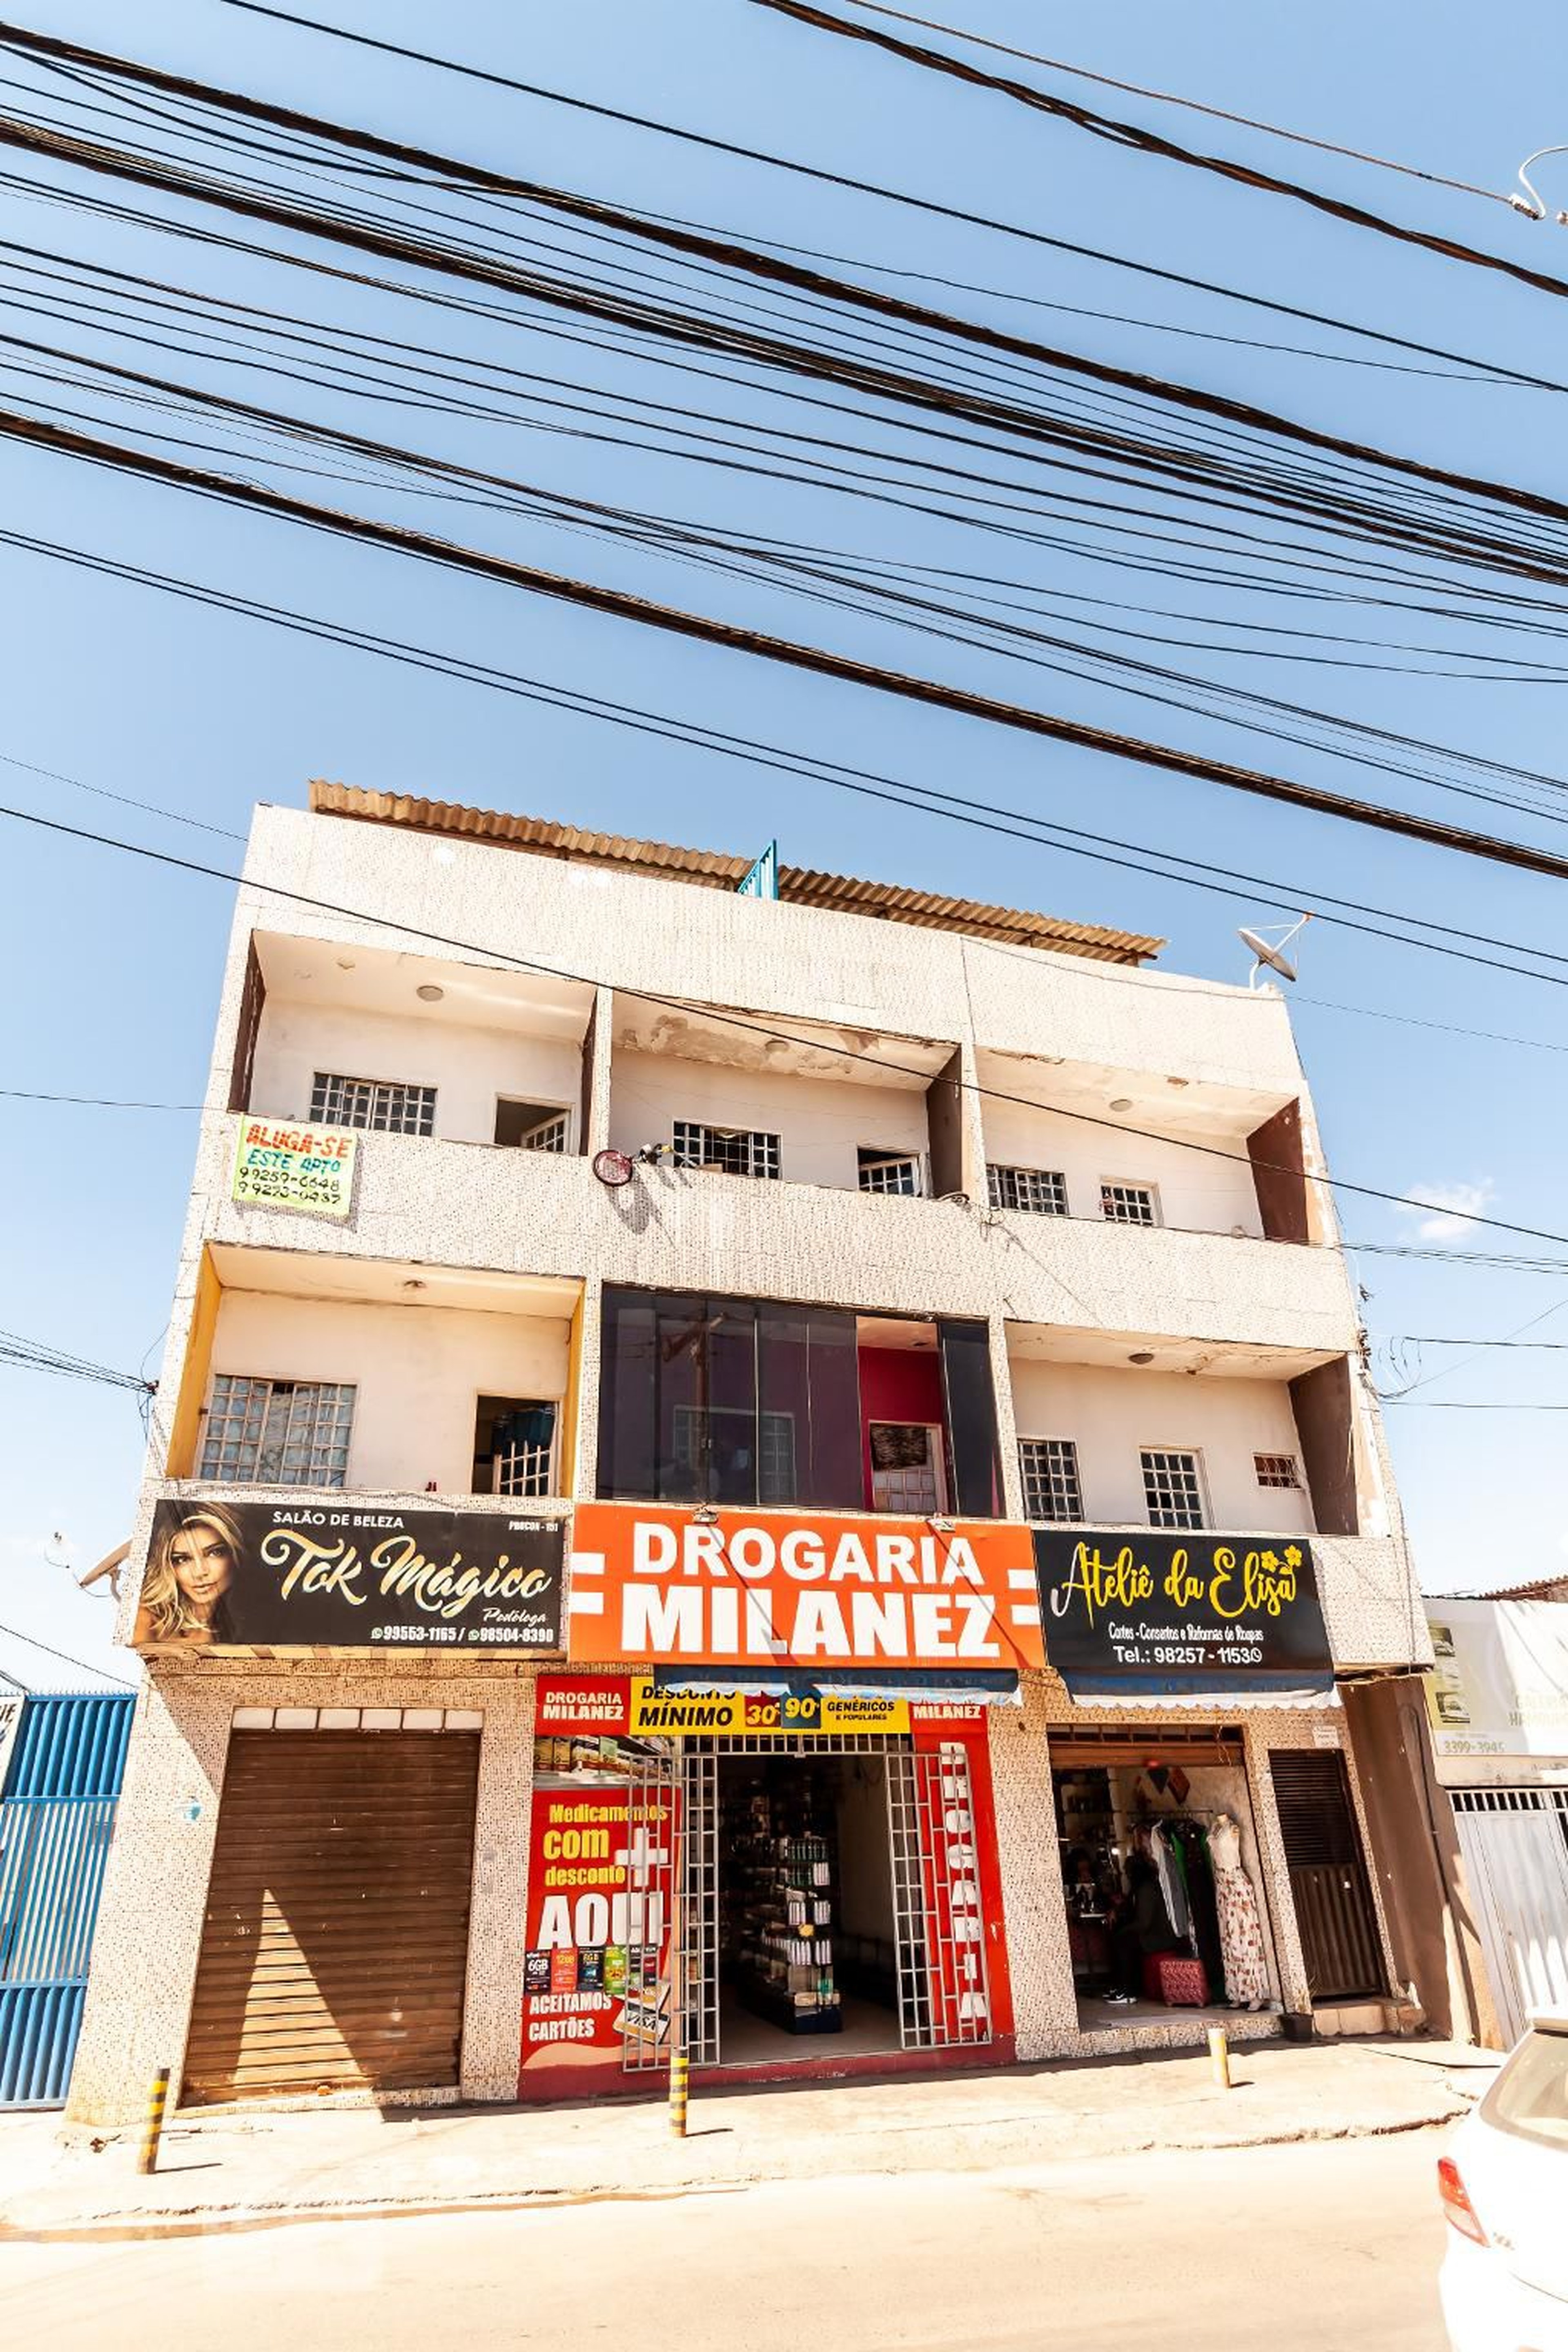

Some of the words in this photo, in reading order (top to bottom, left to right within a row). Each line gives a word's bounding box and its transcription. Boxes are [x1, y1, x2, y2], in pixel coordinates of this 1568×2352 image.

[247, 1124, 352, 1158] ALUGA-SE
[247, 1148, 293, 1169] ESTE
[300, 1157, 341, 1175] APTO
[273, 1510, 326, 1525] SALÃO
[330, 1514, 350, 1526] DE
[353, 1515, 404, 1528] BELEZA
[633, 1522, 984, 1585] DROGARIA
[261, 1528, 367, 1606] Tok
[371, 1535, 552, 1618] Mágico
[1051, 1541, 1154, 1629] Ateliê
[1164, 1549, 1205, 1607] da
[1209, 1548, 1297, 1617] Elisa
[621, 1583, 1000, 1658] MILANEZ
[1108, 1621, 1134, 1640] Cortes
[1180, 1628, 1186, 1641] e
[1225, 1626, 1235, 1642] de
[1235, 1625, 1264, 1644] Roupas
[1113, 1646, 1151, 1663] Tel.:
[546, 1691, 622, 1704] DROGARIA
[827, 1699, 895, 1711] GENÉRICOS
[543, 1705, 624, 1720] MILANEZ
[638, 1700, 733, 1726] MÍNIMO
[913, 1705, 982, 1719] MILANEZ
[550, 1804, 668, 1824] Medicamentos
[543, 1829, 609, 1860] com
[545, 1865, 626, 1886] desconto
[530, 1991, 612, 2015] ACEITAMOS
[529, 2016, 595, 2041] CARTÕES
